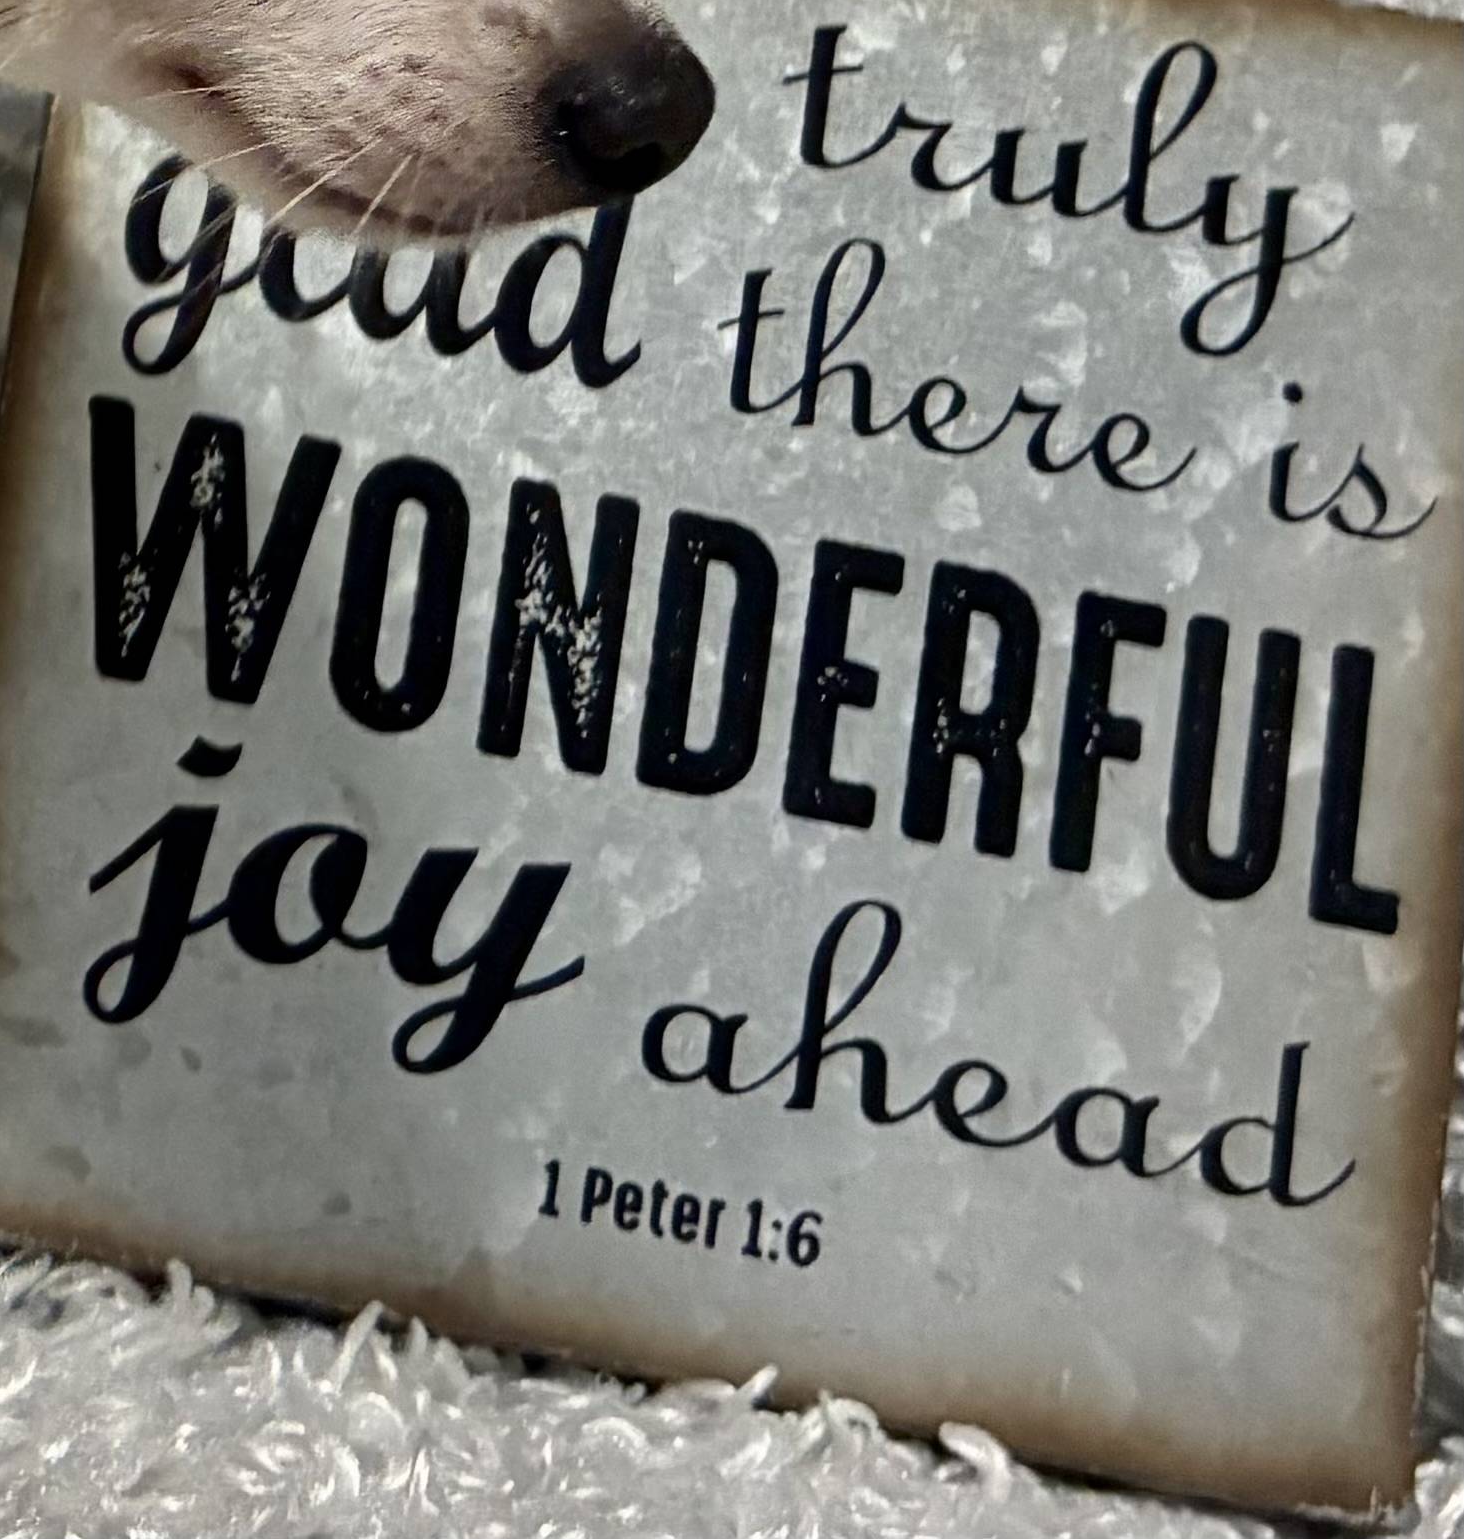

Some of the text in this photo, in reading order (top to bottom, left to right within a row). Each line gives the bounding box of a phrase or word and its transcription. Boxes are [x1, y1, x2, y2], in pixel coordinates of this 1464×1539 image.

[781, 23, 1355, 358] truly
[717, 237, 1197, 494] there
[1267, 381, 1437, 541] is
[87, 393, 1402, 937] WONDERFUL
[82, 735, 1357, 1210] joy ahead
[538, 1158, 824, 1269] 1 Peter 1:6
